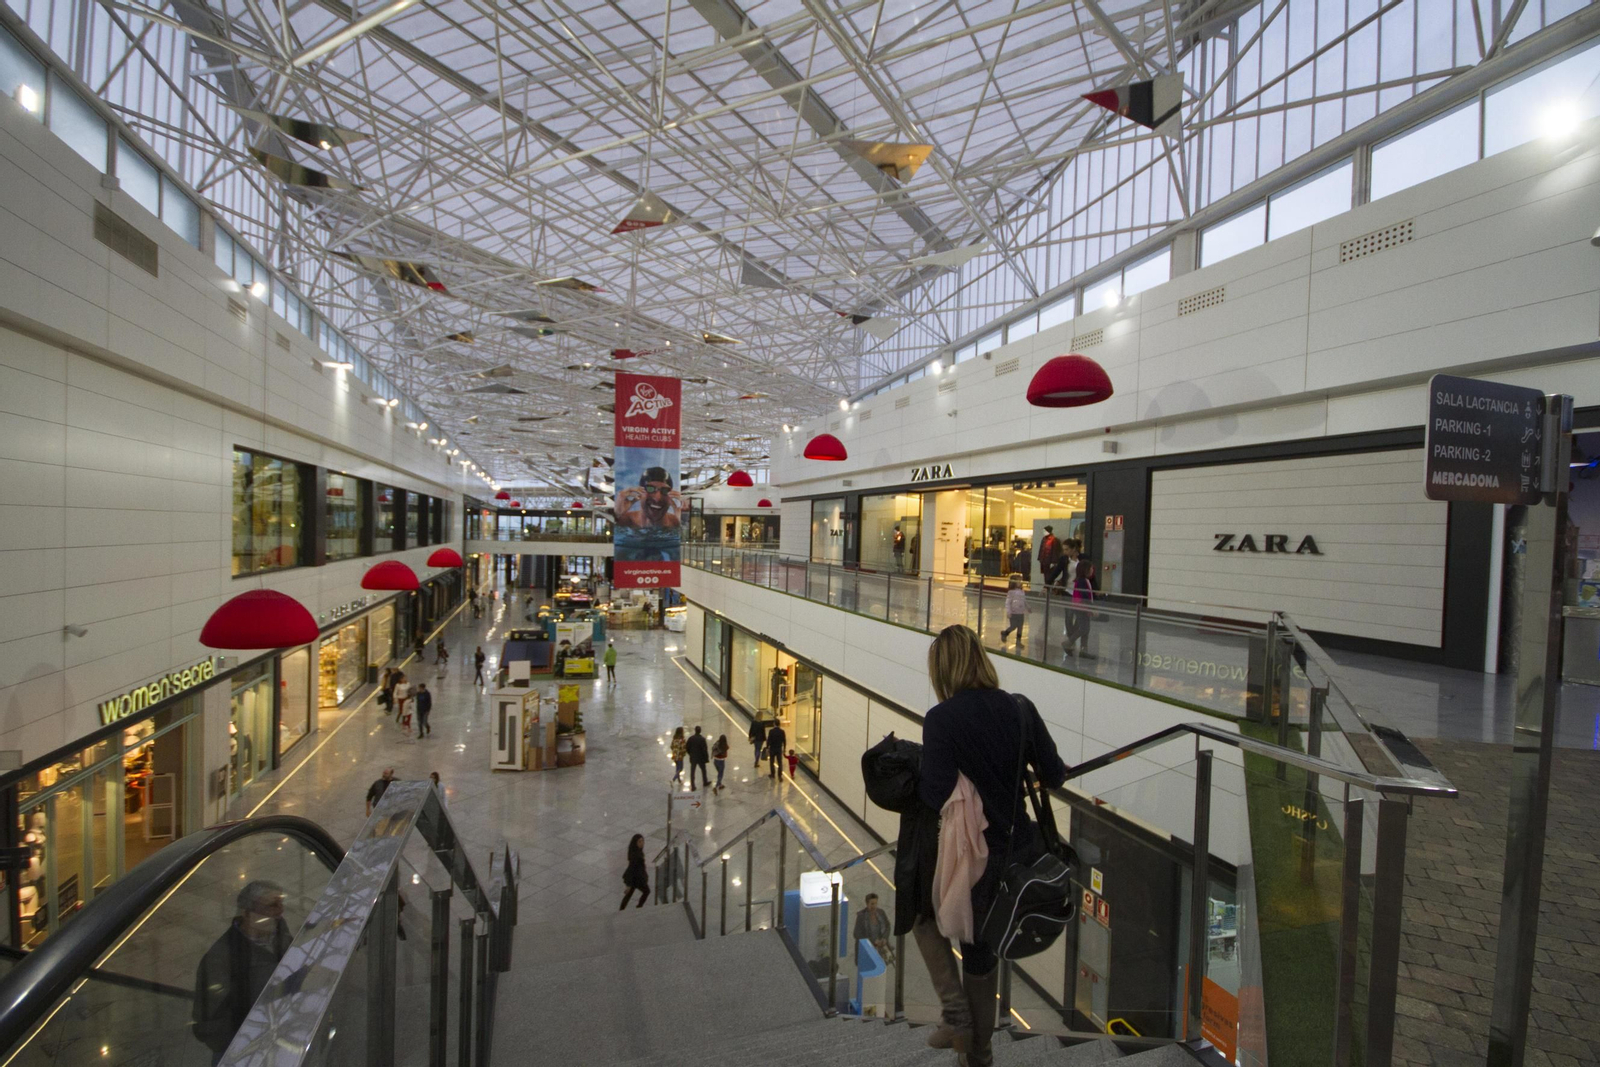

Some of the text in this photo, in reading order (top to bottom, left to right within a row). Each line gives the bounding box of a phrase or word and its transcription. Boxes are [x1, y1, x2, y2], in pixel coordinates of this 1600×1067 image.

[630, 399, 671, 413] ACTIVE
[1436, 391, 1519, 415] SALA LACTANCIA
[1435, 418, 1491, 437] PARKING -1
[1434, 444, 1491, 462] PARKING -2
[911, 463, 954, 482] ZARA
[1432, 471, 1500, 488] MERCADONA
[1213, 534, 1325, 556] ZARA
[98, 656, 216, 726] women'secret
